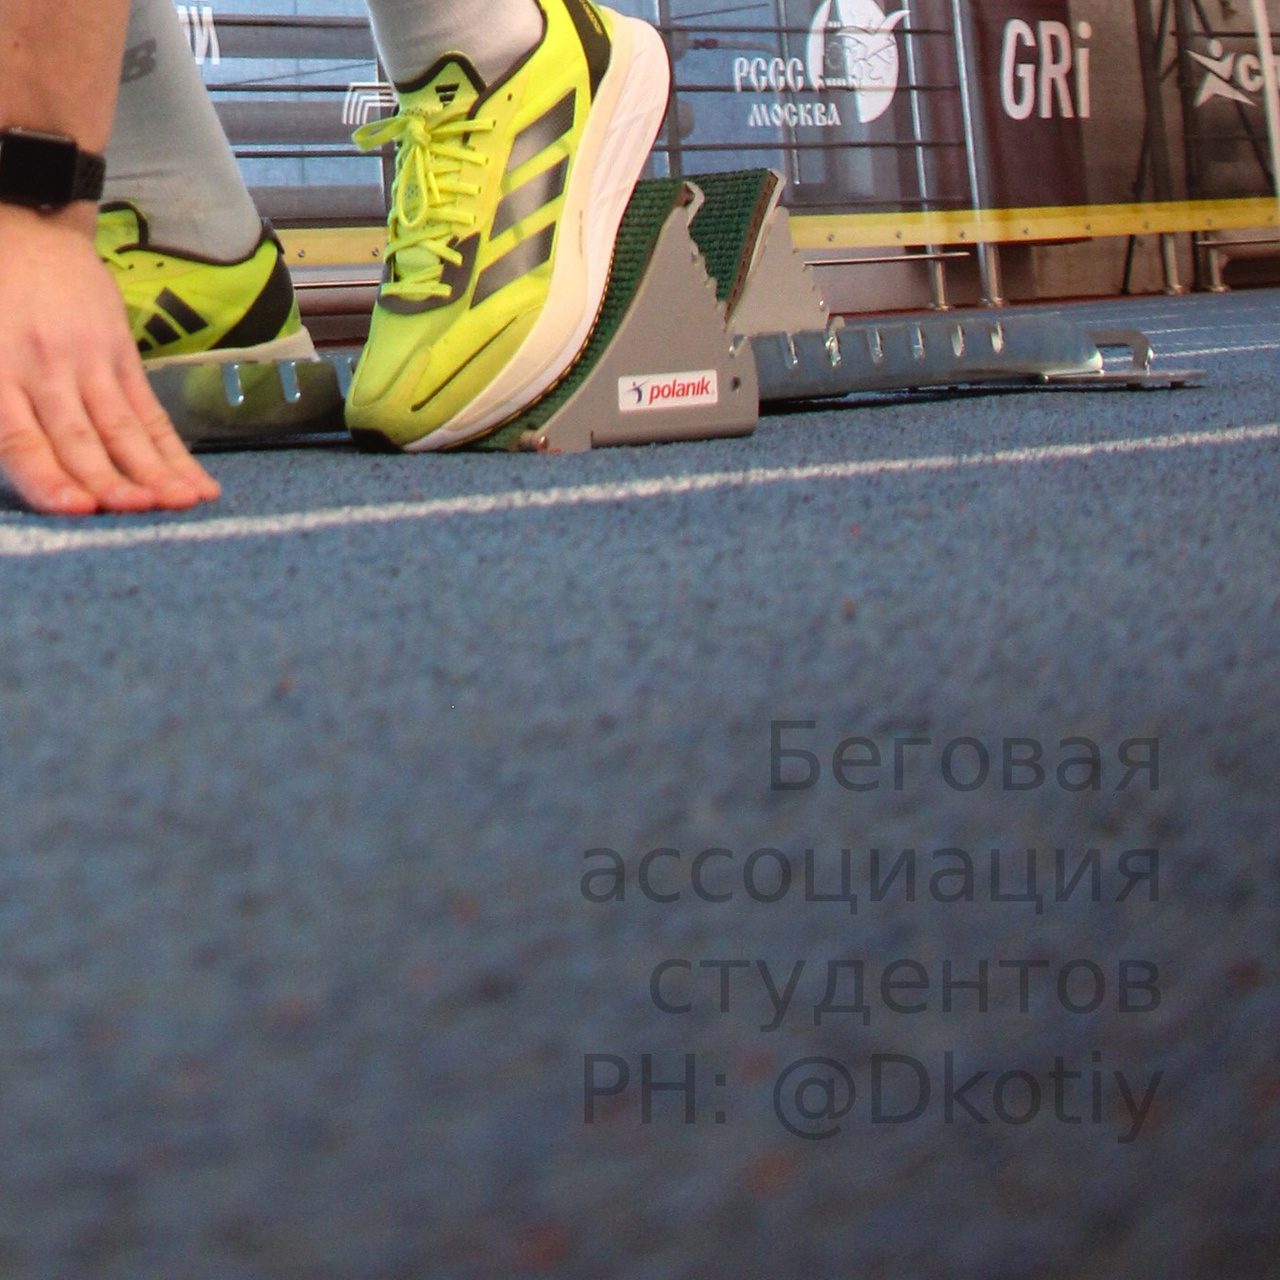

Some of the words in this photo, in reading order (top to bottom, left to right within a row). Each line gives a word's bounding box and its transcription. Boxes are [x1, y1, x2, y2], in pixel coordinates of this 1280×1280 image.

[1001, 18, 1092, 120] GRi
[748, 103, 841, 127] МОСКВА
[648, 376, 711, 405] polanik
